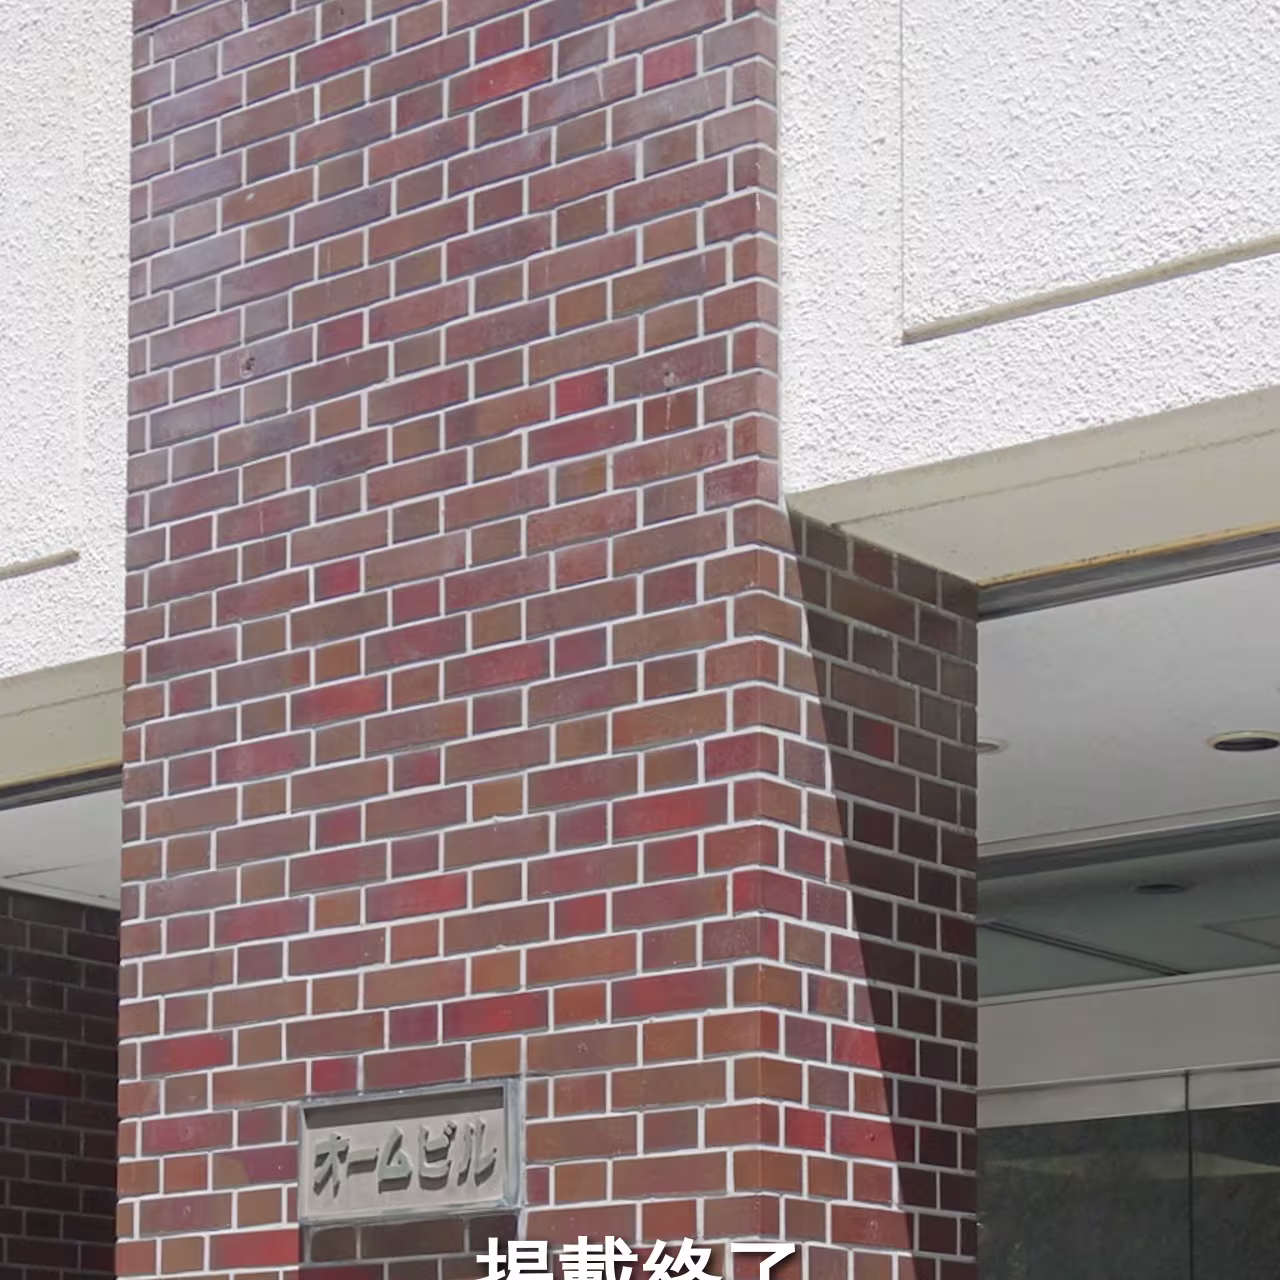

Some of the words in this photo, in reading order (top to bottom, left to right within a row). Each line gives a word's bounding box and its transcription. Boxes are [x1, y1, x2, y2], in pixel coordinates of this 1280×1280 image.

[312, 1116, 498, 1197] オームビル
